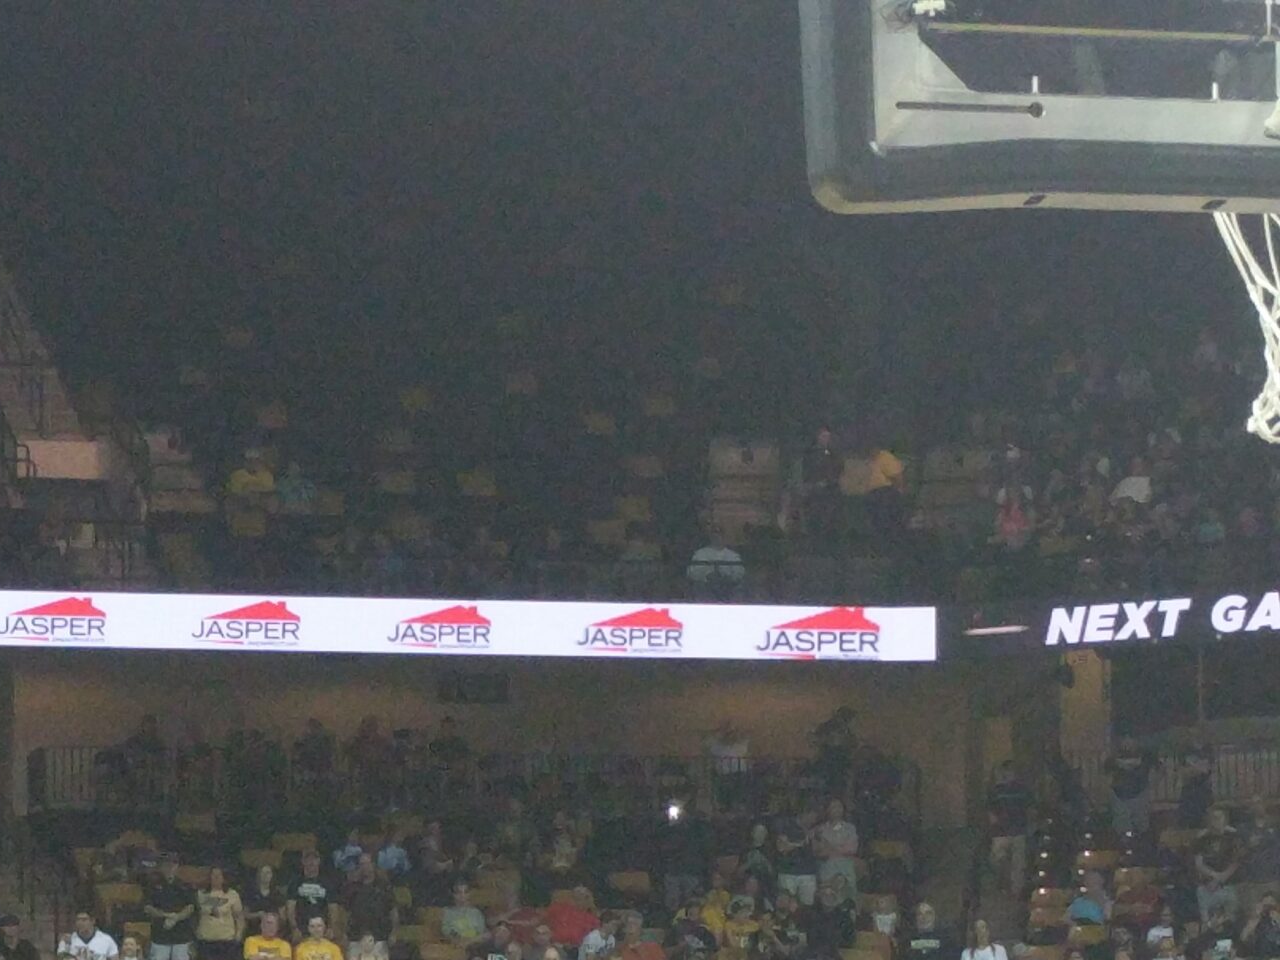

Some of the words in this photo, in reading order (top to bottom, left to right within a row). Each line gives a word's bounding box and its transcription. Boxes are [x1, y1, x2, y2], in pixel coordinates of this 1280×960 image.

[1045, 598, 1191, 645] NEXT
[1211, 592, 1280, 632] GA
[191, 620, 300, 641] JASPER
[387, 624, 491, 644] JASPER
[577, 628, 683, 647] JASPER
[756, 630, 880, 653] JASPER
